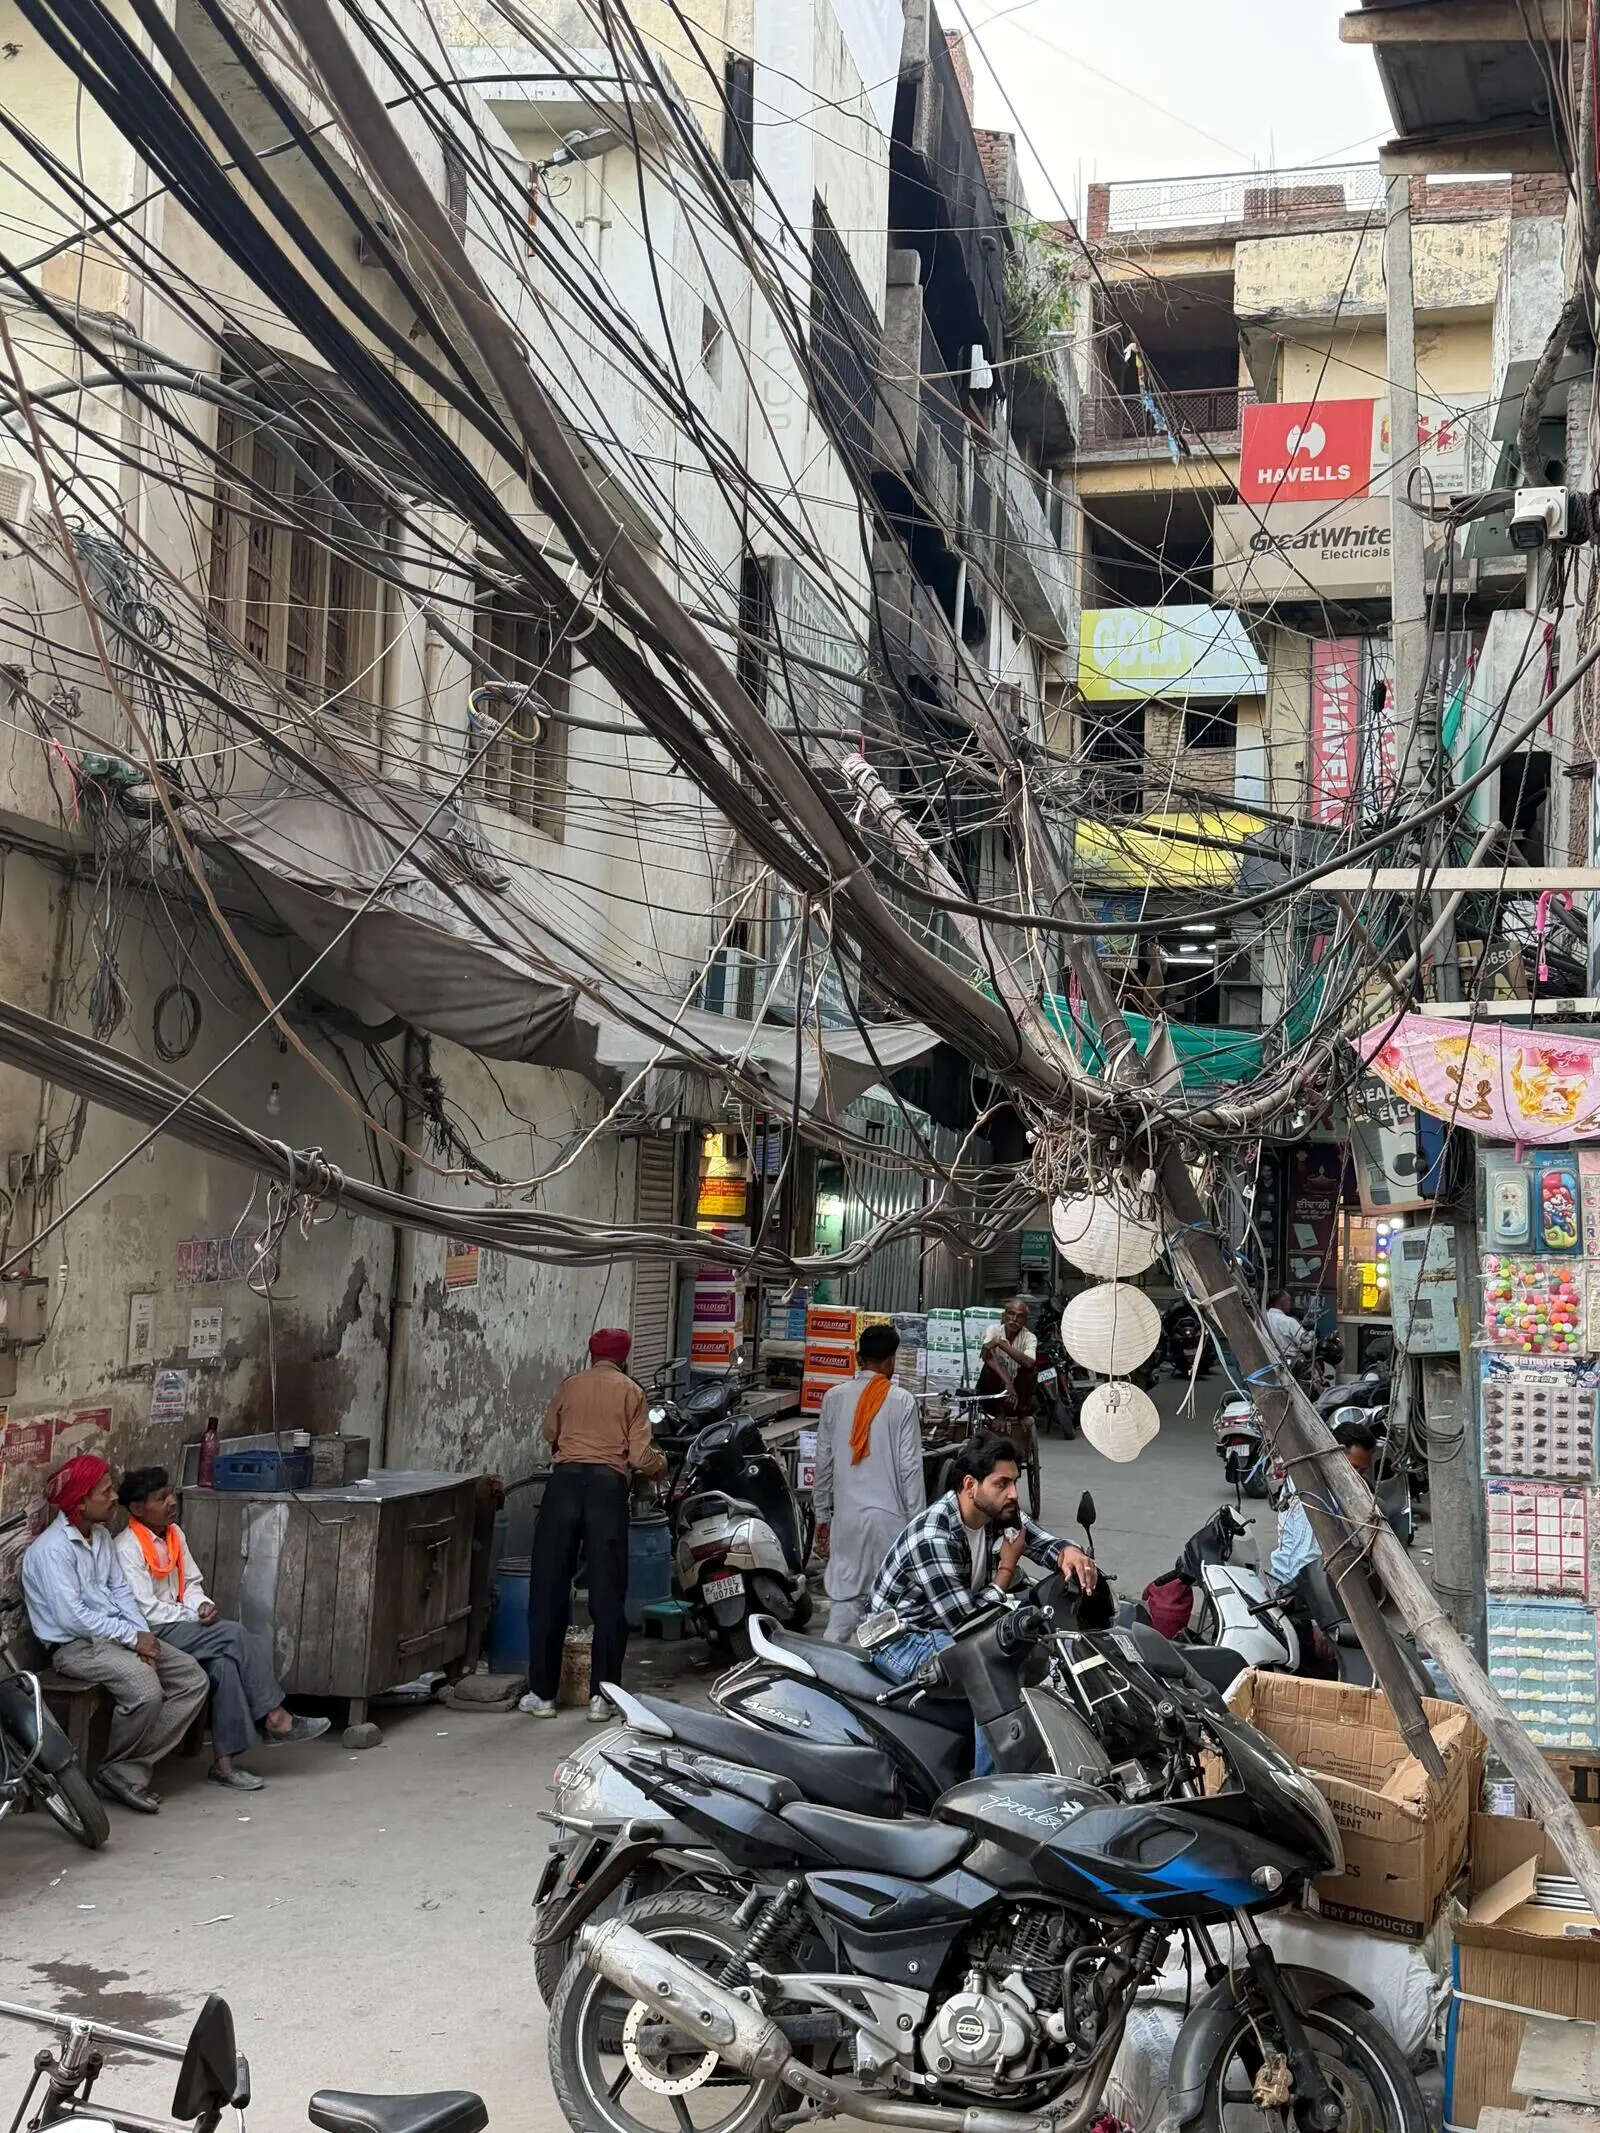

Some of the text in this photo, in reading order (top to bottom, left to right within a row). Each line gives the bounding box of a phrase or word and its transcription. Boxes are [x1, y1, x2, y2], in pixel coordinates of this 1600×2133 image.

[1258, 465, 1351, 484] HAVELLS
[1250, 525, 1391, 551] GreatWhite
[1321, 547, 1390, 561] Electricals
[696, 1303, 728, 1311] CELLOTAPE
[817, 1320, 850, 1329] CELLOTAPE
[692, 1343, 728, 1351] CELLOTAPE
[814, 1355, 848, 1366] CELLOTAPE
[1349, 1911, 1414, 1935] PRODUCTS
